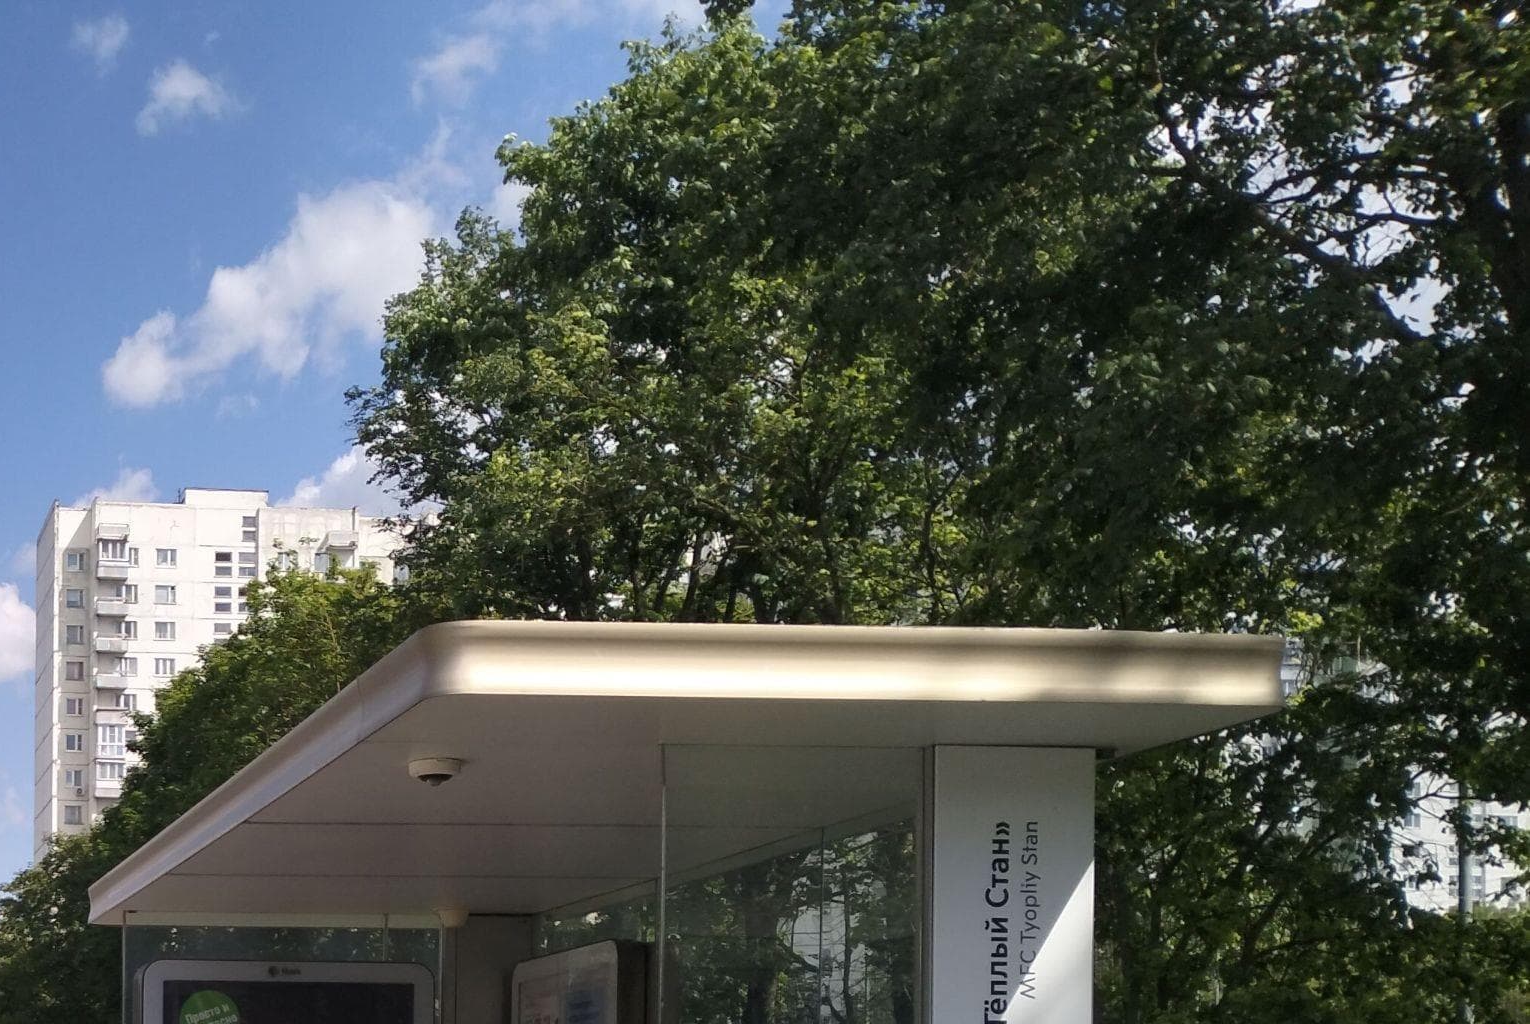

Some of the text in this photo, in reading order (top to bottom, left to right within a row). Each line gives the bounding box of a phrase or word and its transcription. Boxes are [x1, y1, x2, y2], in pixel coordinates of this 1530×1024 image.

[984, 821, 1010, 908] Стан»
[1019, 821, 1041, 1000] MFC Tyopliy Stan
[184, 1006, 221, 1024] Просто
